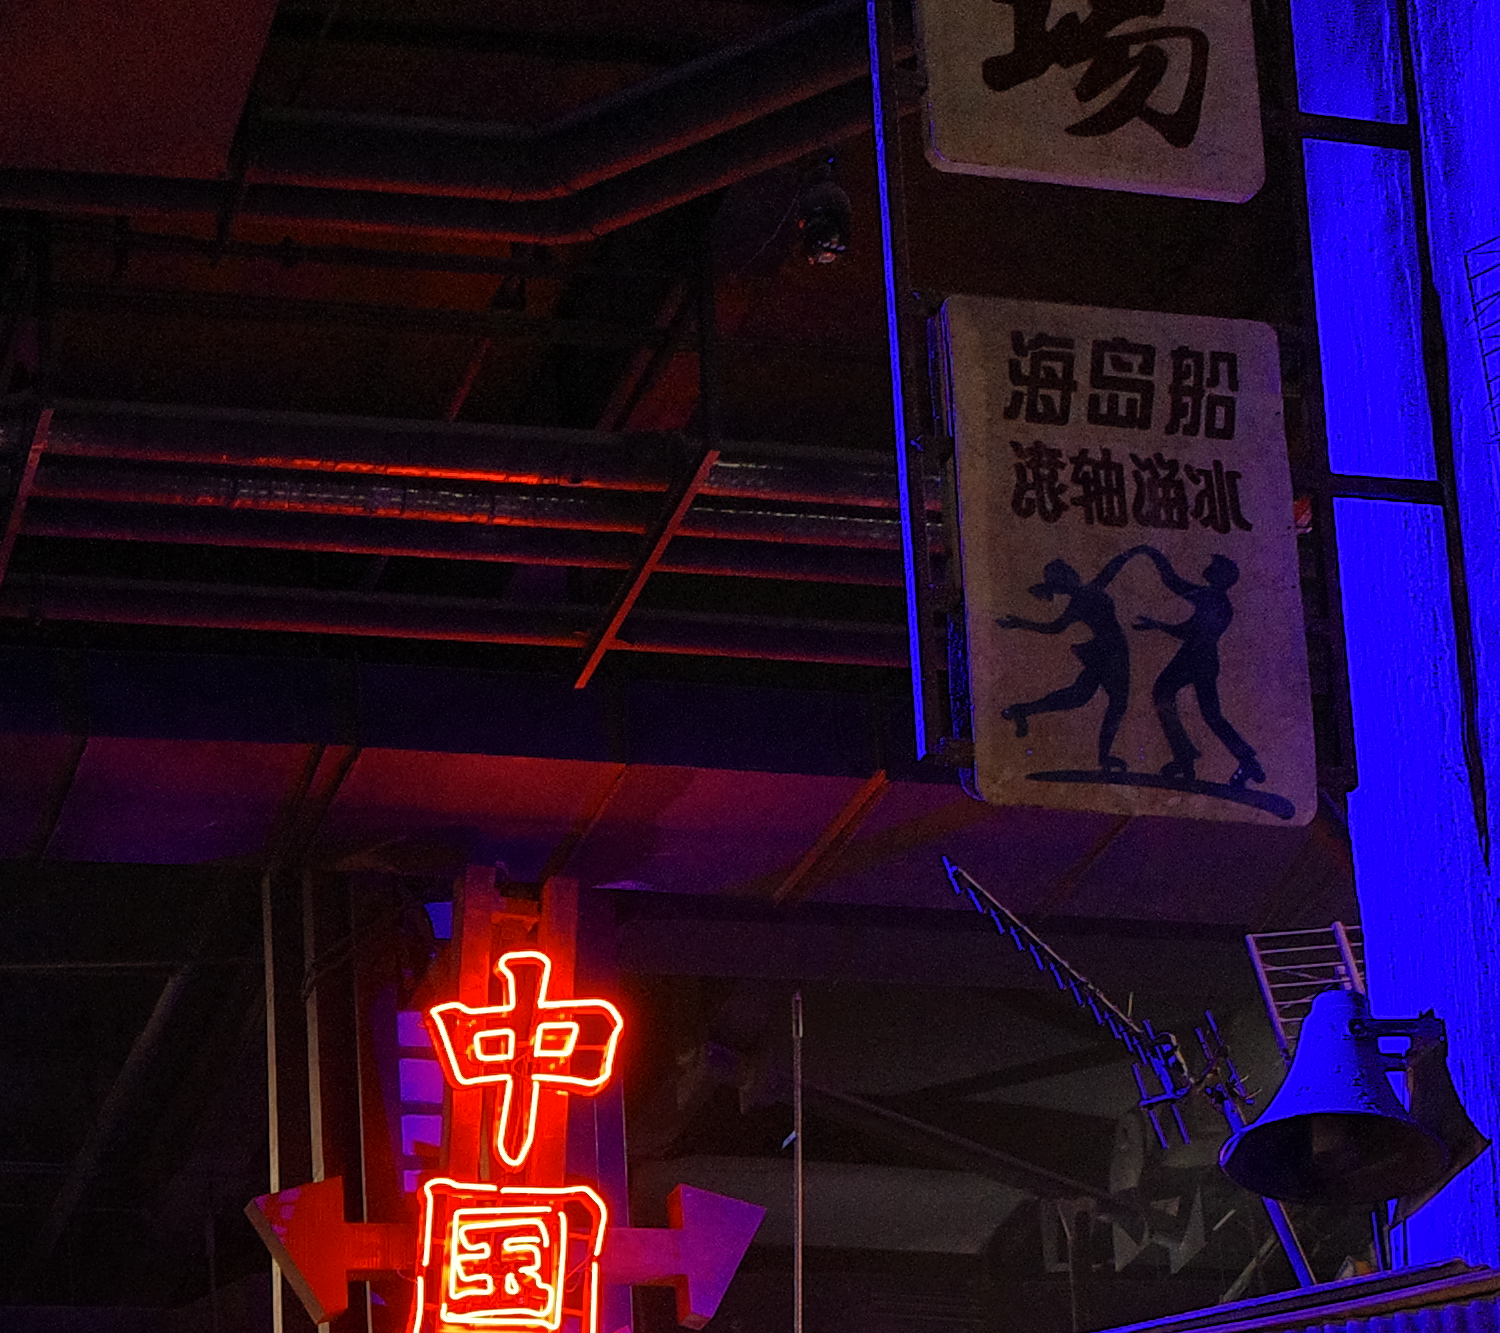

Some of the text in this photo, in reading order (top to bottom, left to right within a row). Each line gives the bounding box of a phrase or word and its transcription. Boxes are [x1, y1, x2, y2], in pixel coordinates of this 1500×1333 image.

[1003, 330, 1239, 440] 海岛船
[1010, 440, 1252, 534] 滚轴溜冰
